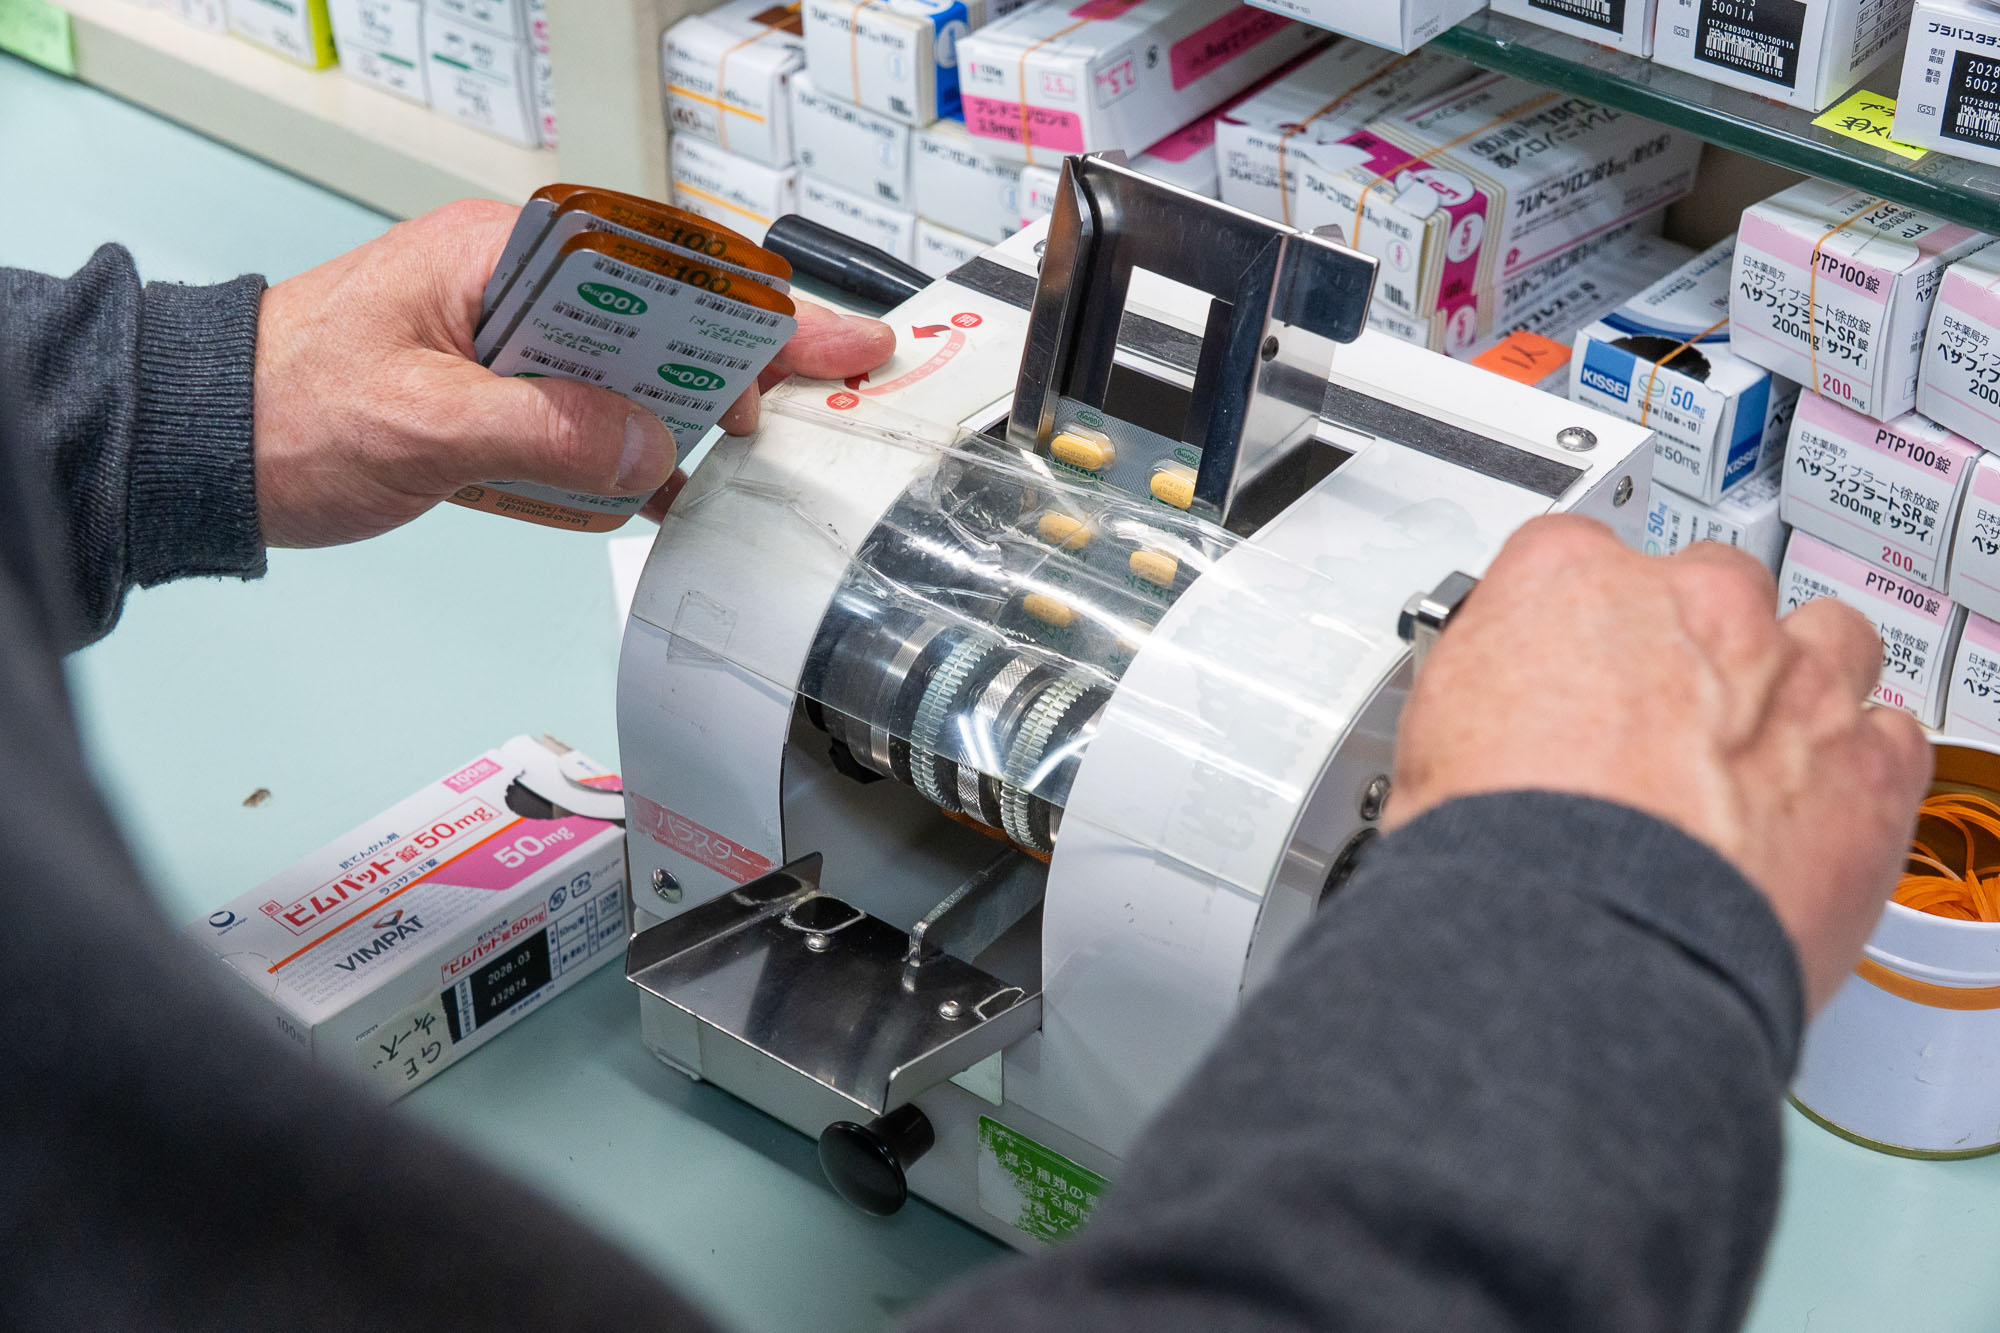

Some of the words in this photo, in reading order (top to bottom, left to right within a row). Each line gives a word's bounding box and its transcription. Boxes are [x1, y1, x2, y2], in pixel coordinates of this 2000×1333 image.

[1711, 1, 1754, 22] 50011A
[1742, 255, 1786, 282] 日本薬局方
[1810, 249, 1881, 295] PTP100錠
[580, 283, 641, 315] 100mg
[1742, 269, 1872, 336] ベザフィブラート徐放錠
[1772, 314, 1869, 371] 200mg「サワイ」
[1943, 315, 1990, 347] 日本薬局方
[660, 365, 719, 391] 100mg
[1582, 368, 1629, 400] KISSEI
[1968, 379, 2000, 409] 200
[1670, 384, 1706, 420] 50mg
[1800, 430, 1849, 460] 日本薬局方
[1875, 428, 1951, 475] PTP100錠
[1796, 456, 1936, 531] ベザフィブラートSR錠
[1799, 444, 1940, 514] ベザフィブラート徐放錠
[495, 499, 589, 527] Lacosamide
[1829, 488, 1935, 546] 200mg「サワイ」
[1865, 571, 1941, 617] PTP100錠
[339, 832, 400, 870] 抗てんかん剤
[493, 826, 575, 869] 50mg
[657, 810, 751, 865] パラスター
[379, 858, 439, 896] ラコサミド錠
[334, 914, 424, 972] VIMPAT
[487, 950, 531, 986] 2028.03
[404, 1040, 442, 1080] GE
